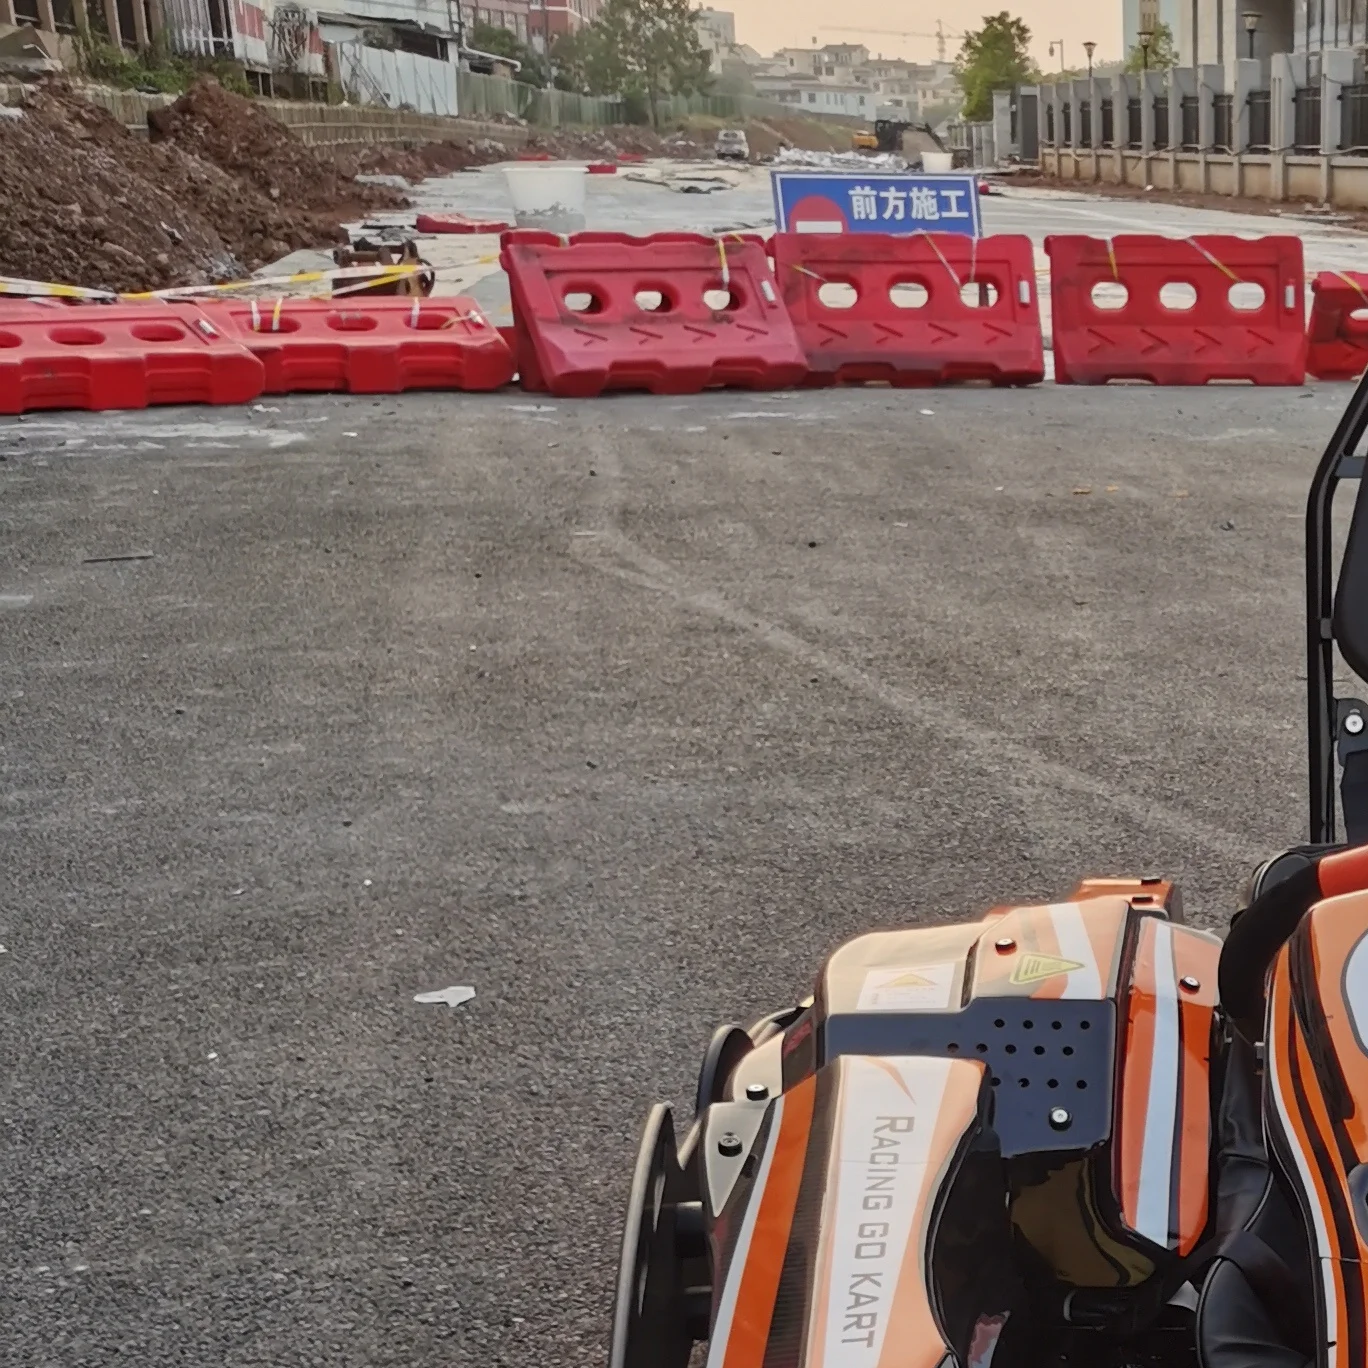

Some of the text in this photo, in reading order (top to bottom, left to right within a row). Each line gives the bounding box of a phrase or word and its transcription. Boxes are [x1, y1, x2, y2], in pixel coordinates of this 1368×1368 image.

[848, 186, 969, 220] 前方施工
[854, 1222, 889, 1260] GO
[841, 1272, 883, 1348] KART
